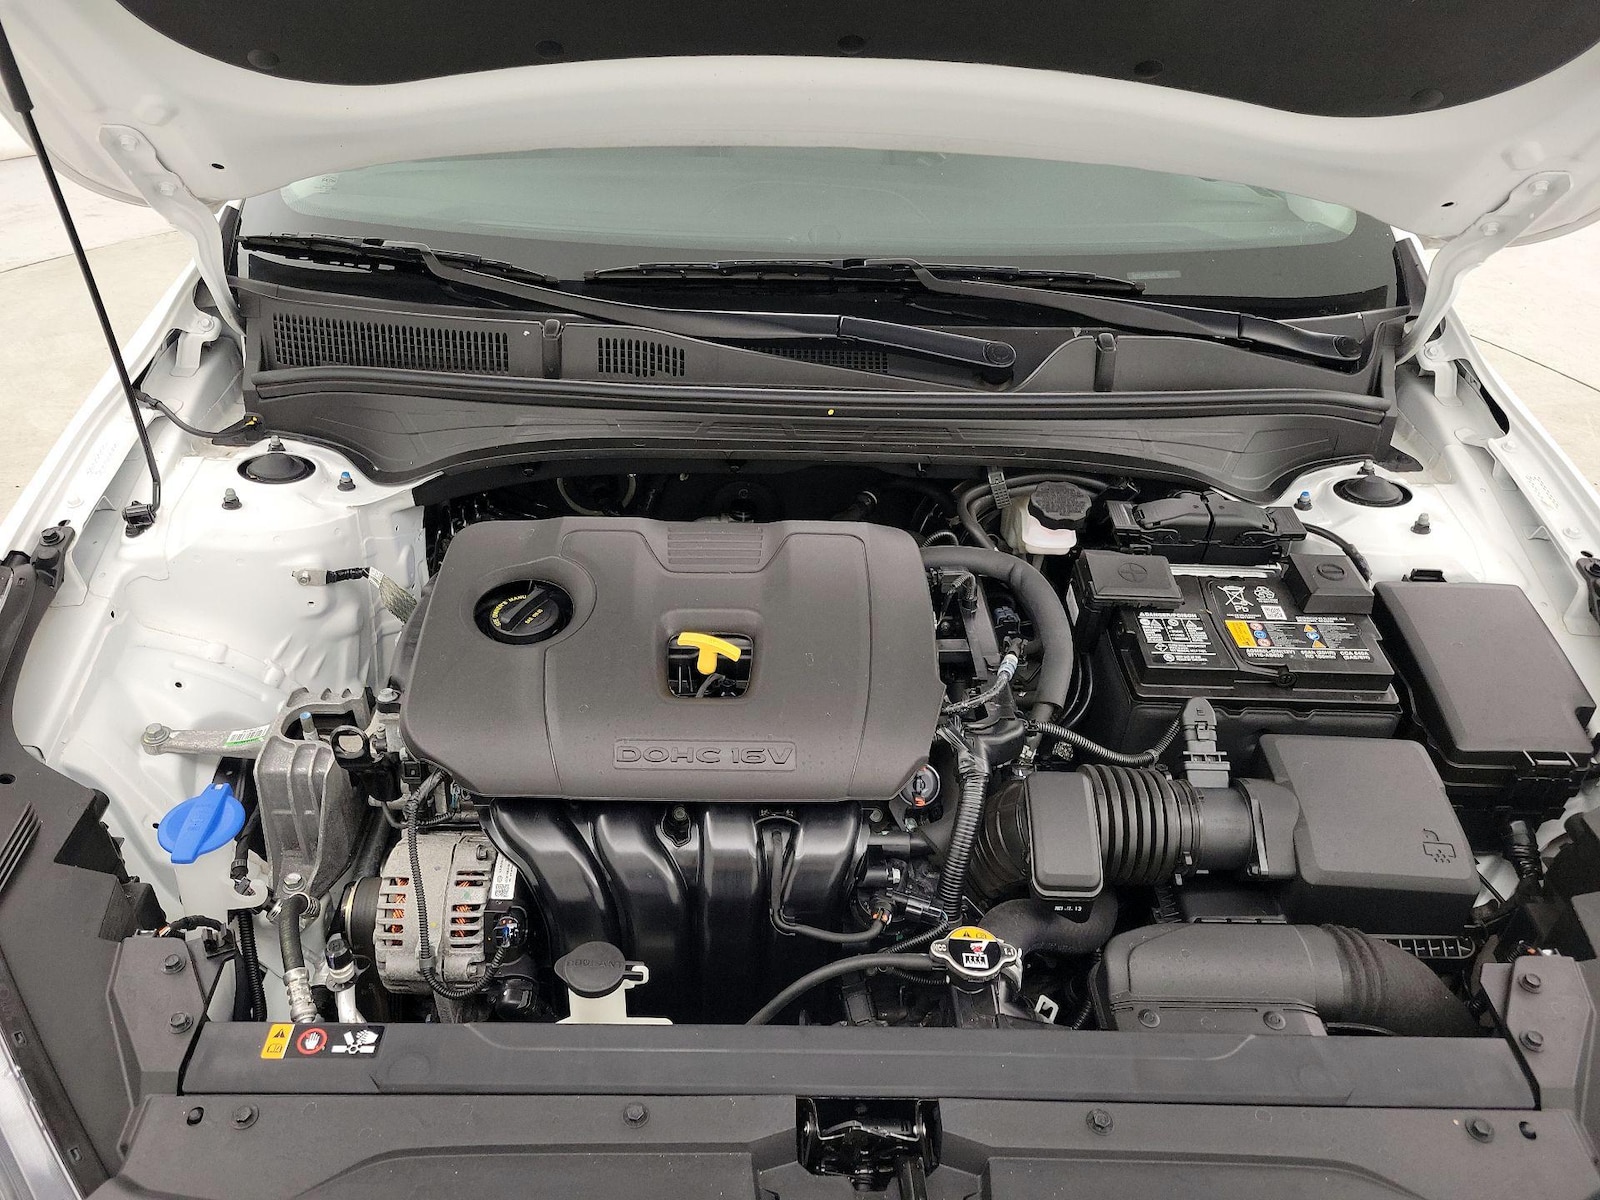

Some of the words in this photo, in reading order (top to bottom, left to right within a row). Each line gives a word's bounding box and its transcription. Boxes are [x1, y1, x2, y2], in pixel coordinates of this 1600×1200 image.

[1234, 605, 1250, 613] Pb
[616, 746, 721, 764] DOHC
[731, 747, 793, 765] 16V
